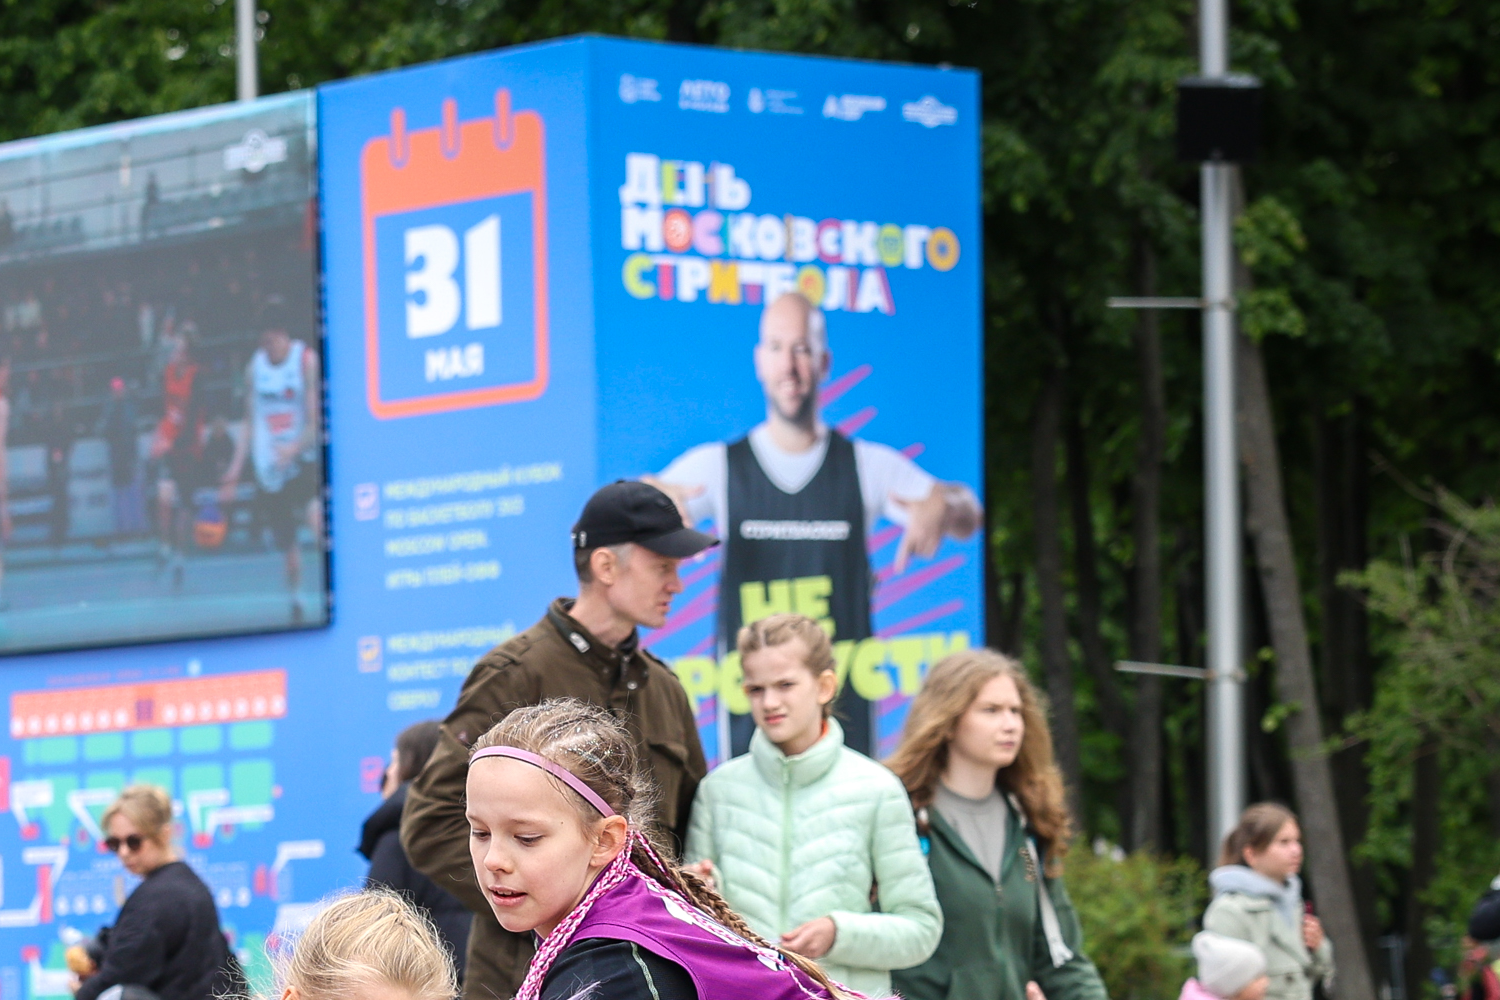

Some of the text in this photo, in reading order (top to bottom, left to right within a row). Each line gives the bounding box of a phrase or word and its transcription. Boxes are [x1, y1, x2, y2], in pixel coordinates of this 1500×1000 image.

[619, 152, 752, 211] ДЕНЬ
[621, 206, 961, 272] МОСКОВСКОГО
[404, 213, 502, 339] 31
[622, 252, 896, 316] СТРИТБОЛА
[425, 343, 484, 382] МАЯ
[739, 575, 836, 640] НЕ
